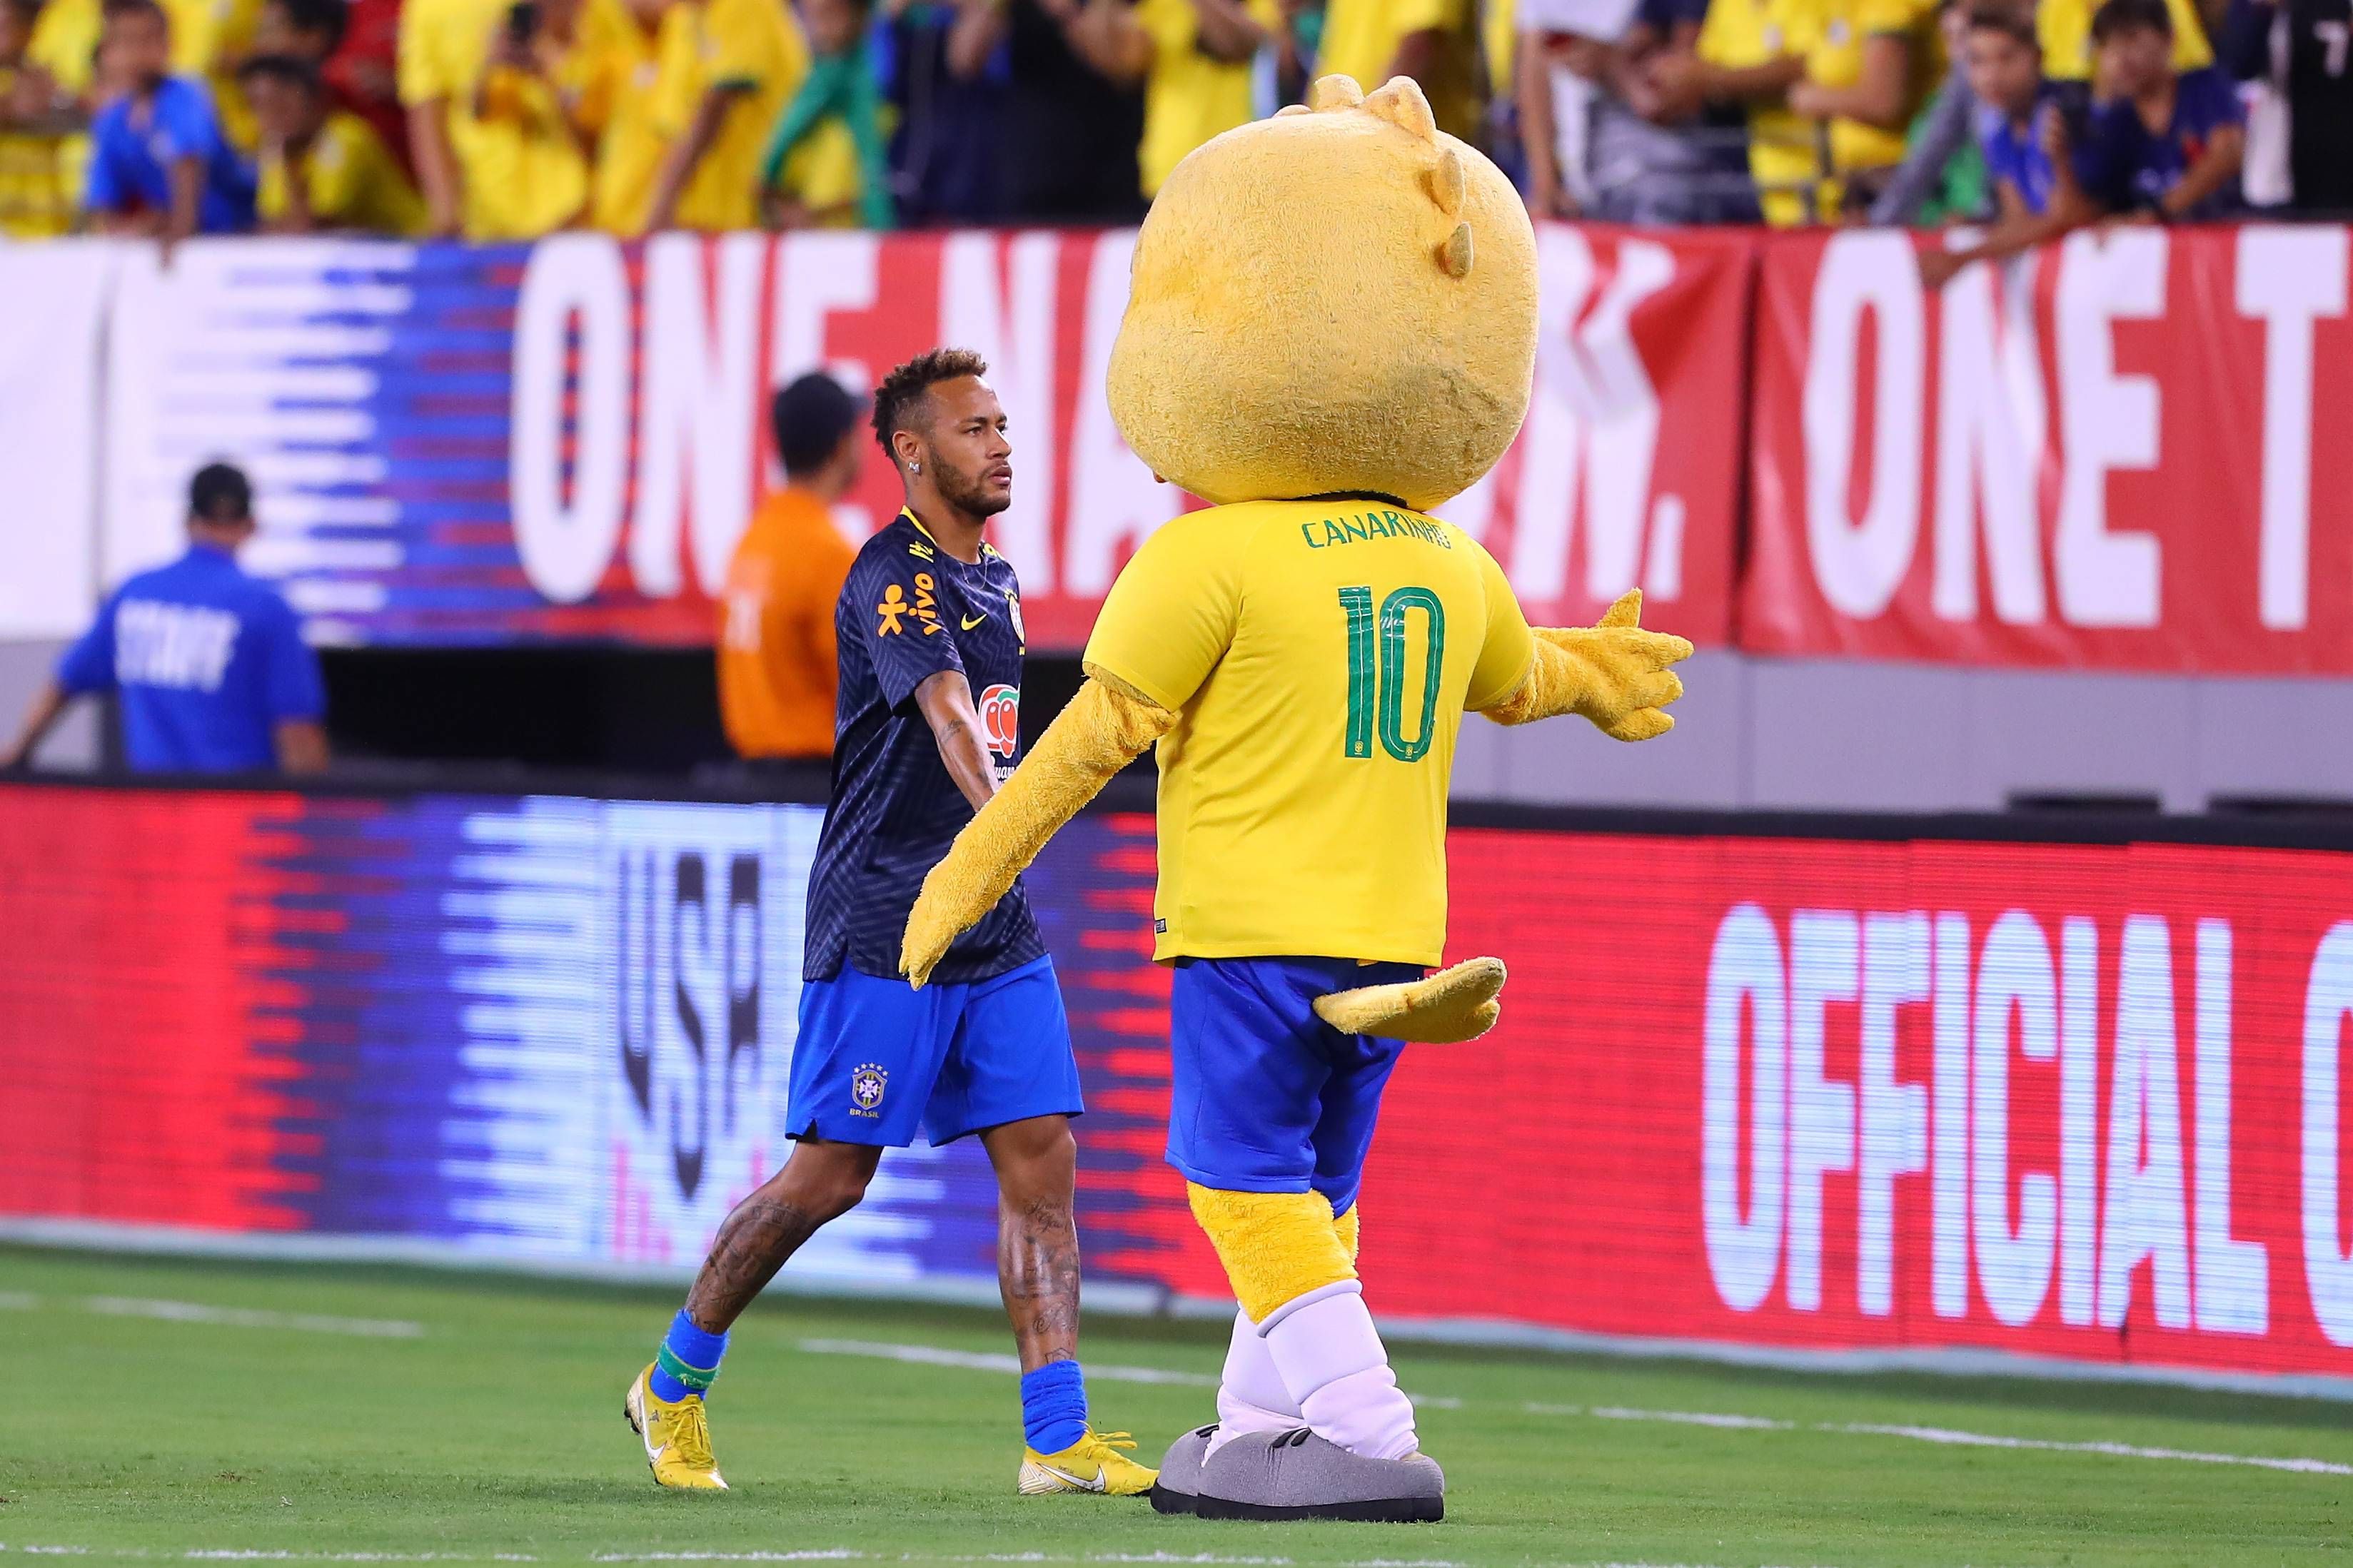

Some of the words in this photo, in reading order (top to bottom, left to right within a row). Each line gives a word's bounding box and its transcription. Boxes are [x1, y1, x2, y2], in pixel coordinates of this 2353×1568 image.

[1803, 226, 2169, 629] ONE
[1301, 510, 1451, 550] CANARINHO
[908, 572, 942, 635] vivo
[1338, 585, 1444, 762] 10
[849, 1108, 879, 1118] BRASIL
[1701, 899, 2271, 1337] OFFICIAL
